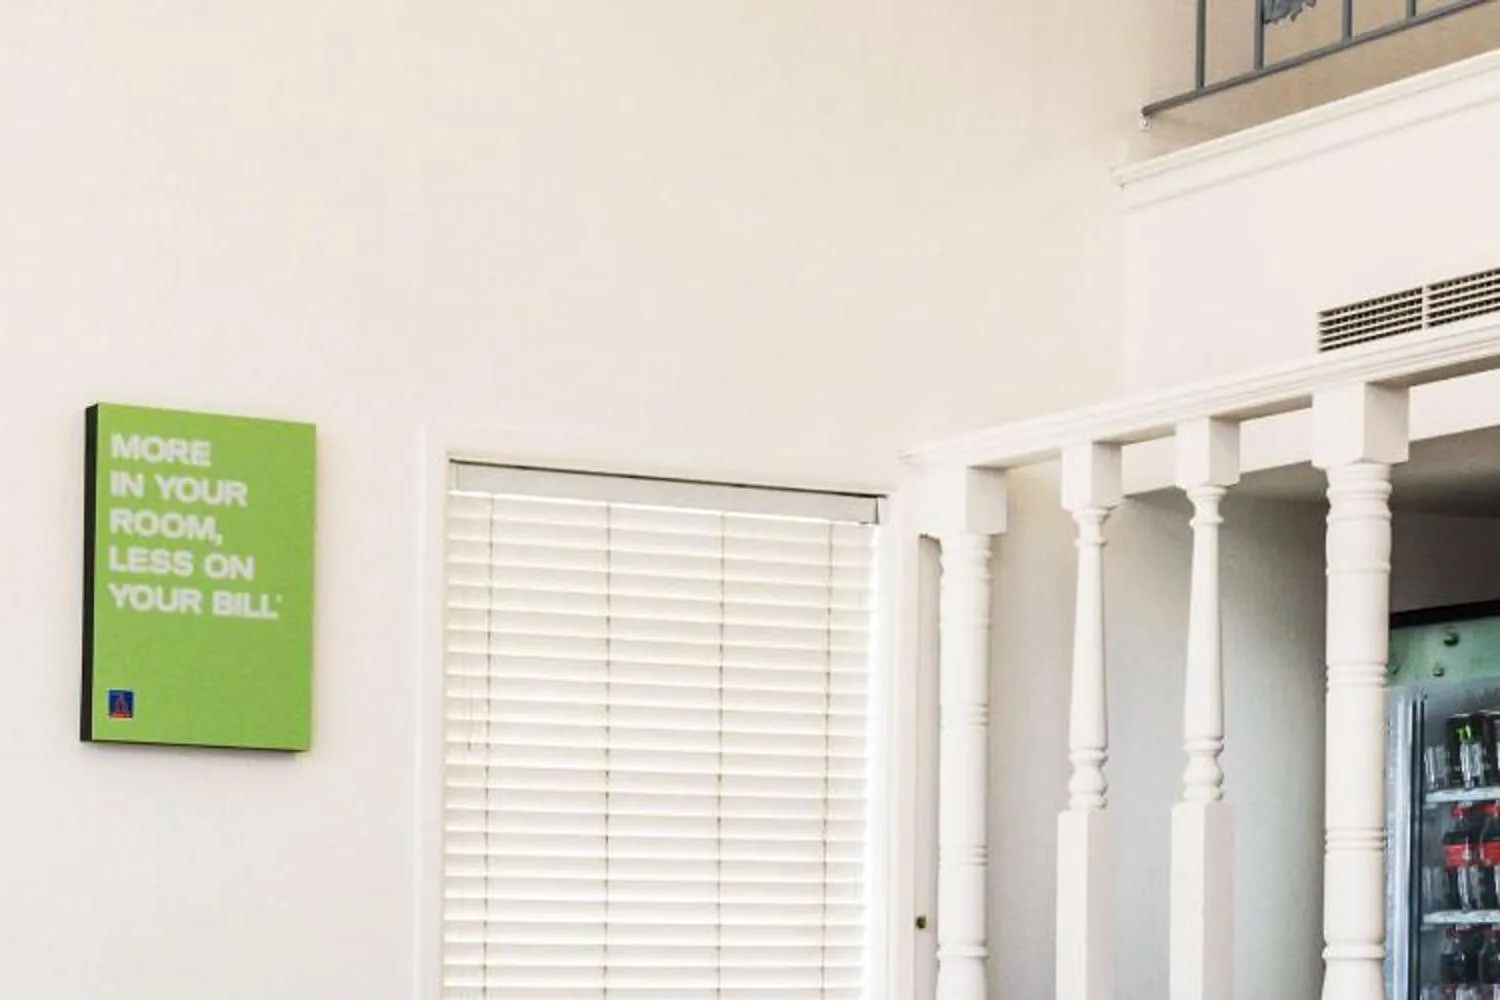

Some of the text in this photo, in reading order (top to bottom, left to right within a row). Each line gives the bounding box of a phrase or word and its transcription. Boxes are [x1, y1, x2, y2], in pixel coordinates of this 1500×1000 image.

[110, 432, 211, 466] MORE
[110, 470, 248, 507] IN YOUR
[109, 508, 223, 546] ROOM,
[108, 546, 255, 580] LESS ON
[108, 583, 202, 614] YOUR
